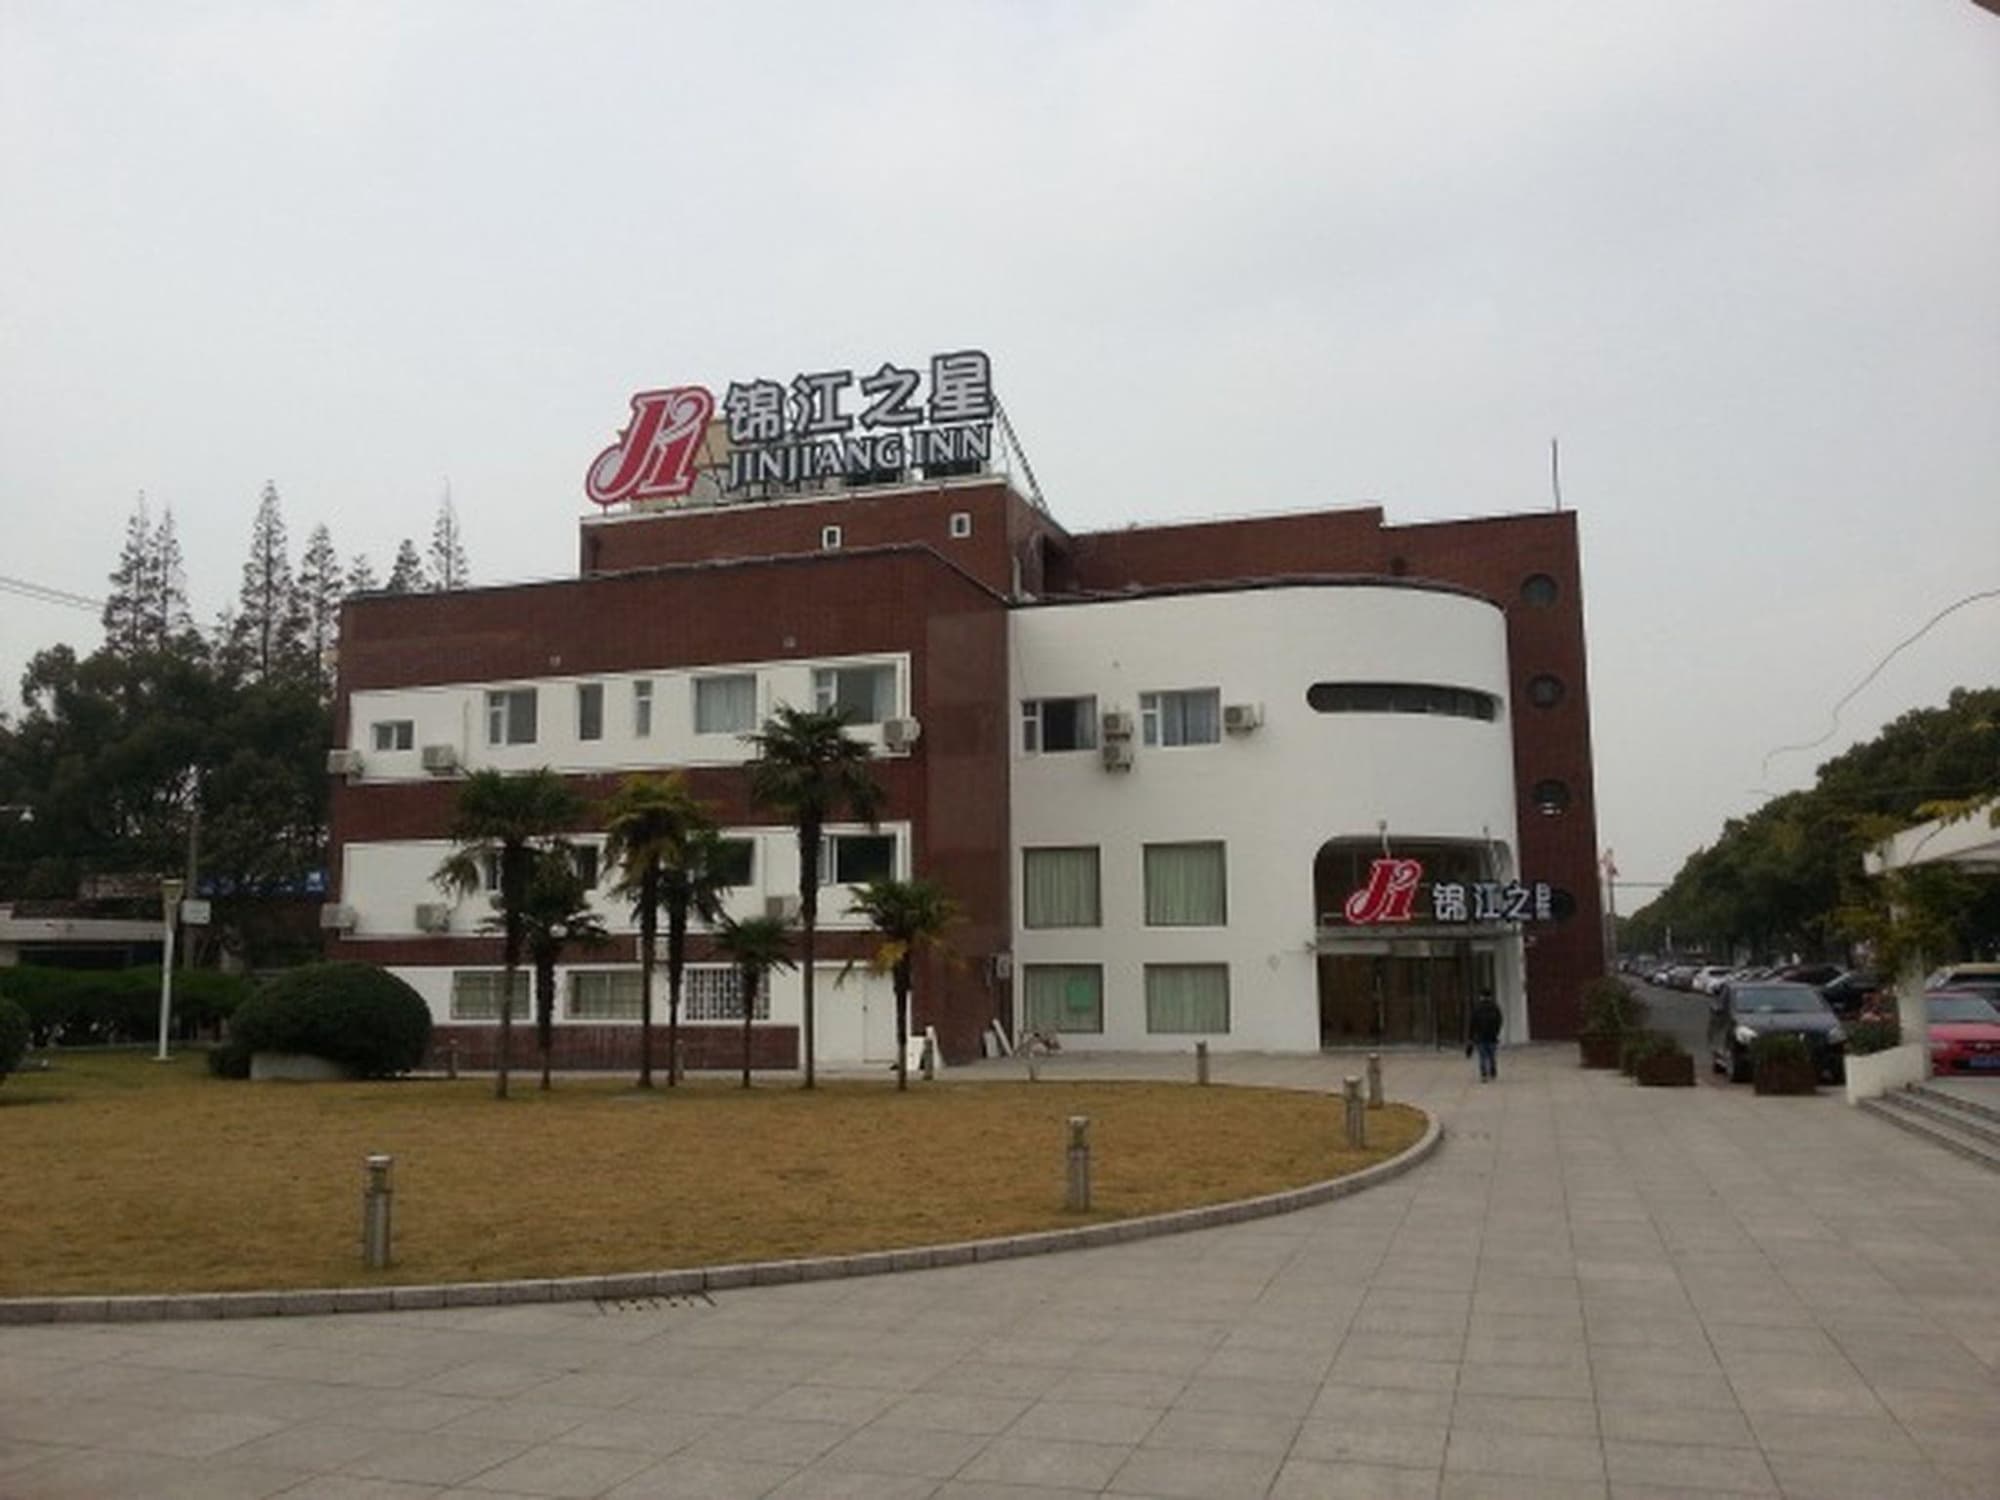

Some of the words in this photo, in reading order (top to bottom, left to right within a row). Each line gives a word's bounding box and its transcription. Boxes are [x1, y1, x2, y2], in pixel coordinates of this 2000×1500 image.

[724, 351, 994, 444] 锦江之星
[727, 434, 903, 491] JINJIANG
[911, 424, 992, 467] INN
